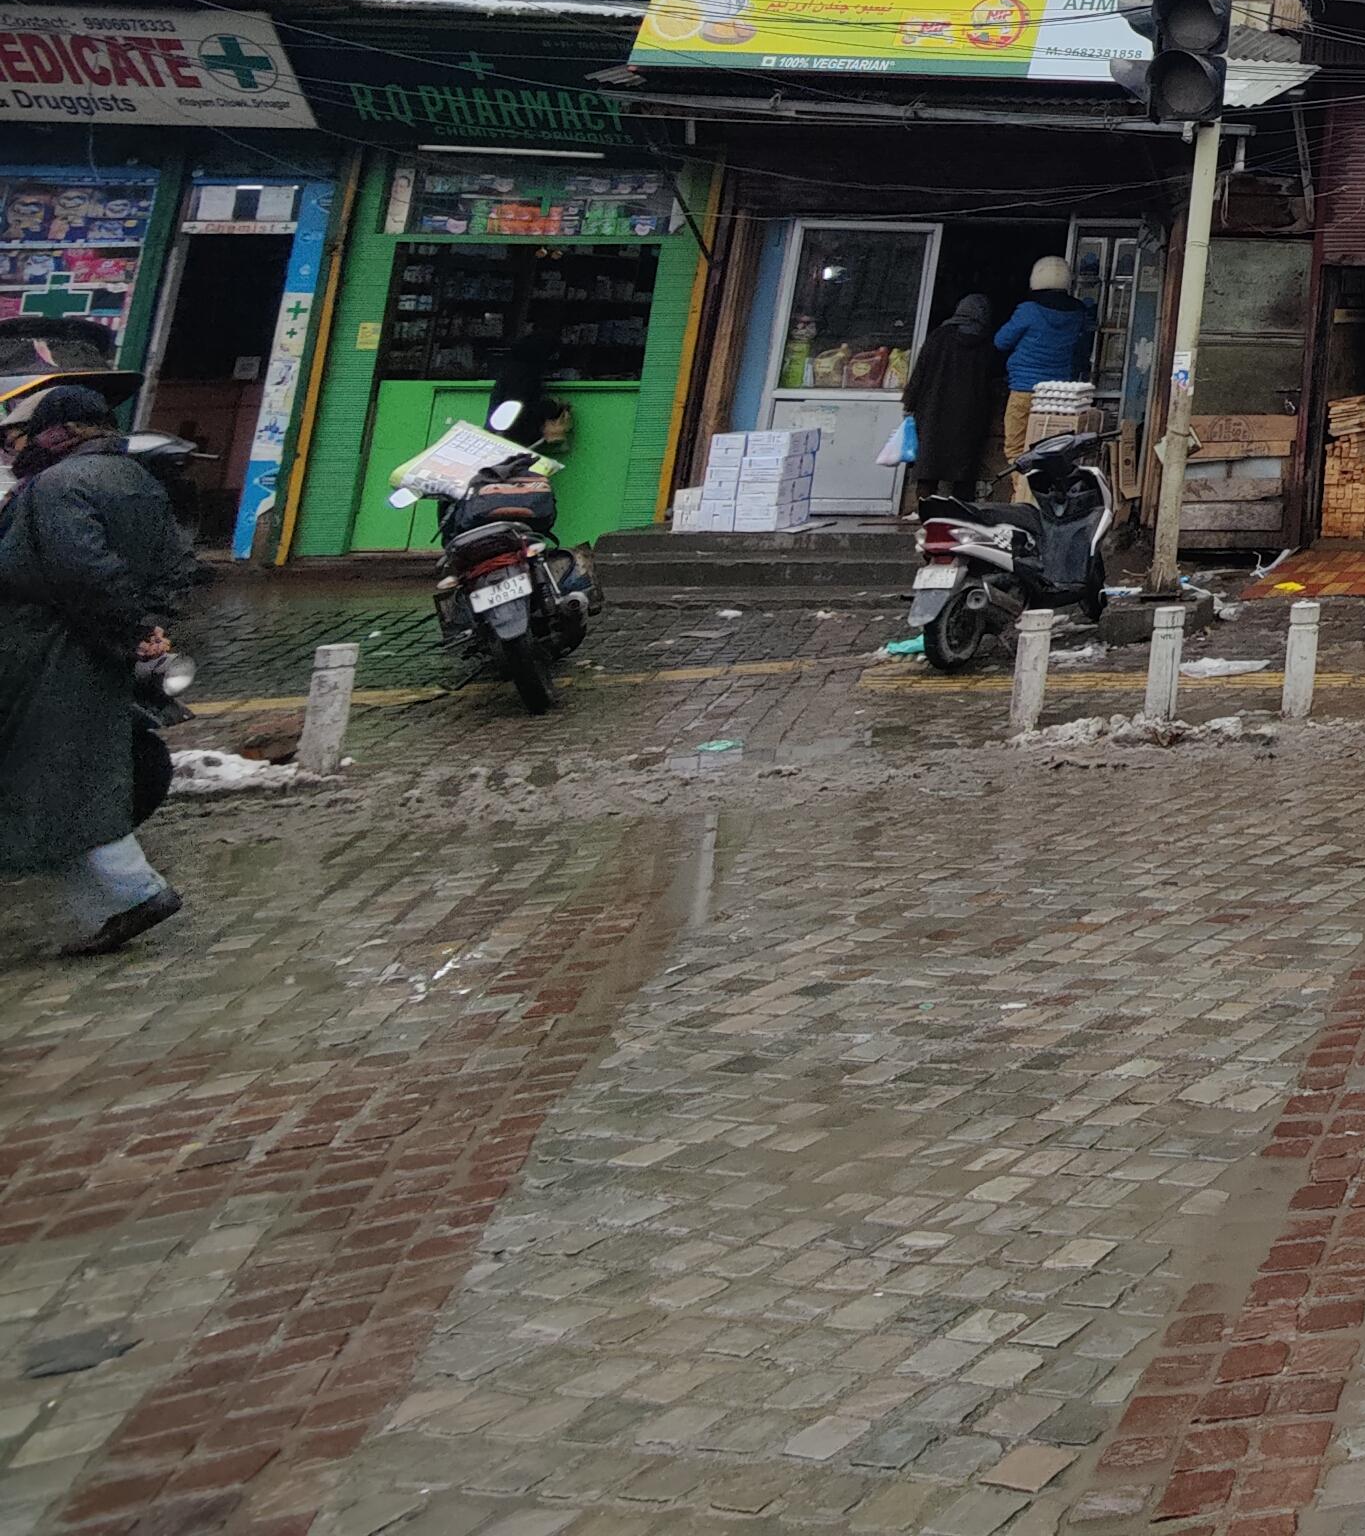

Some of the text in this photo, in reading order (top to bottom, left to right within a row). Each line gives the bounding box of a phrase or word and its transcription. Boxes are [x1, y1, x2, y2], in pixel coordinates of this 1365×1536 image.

[0, 31, 203, 89] EDICATE
[778, 56, 810, 69] 100%
[11, 89, 137, 116] Druggists
[416, 84, 624, 133] PHARMACY
[205, 222, 276, 234] Chemist
